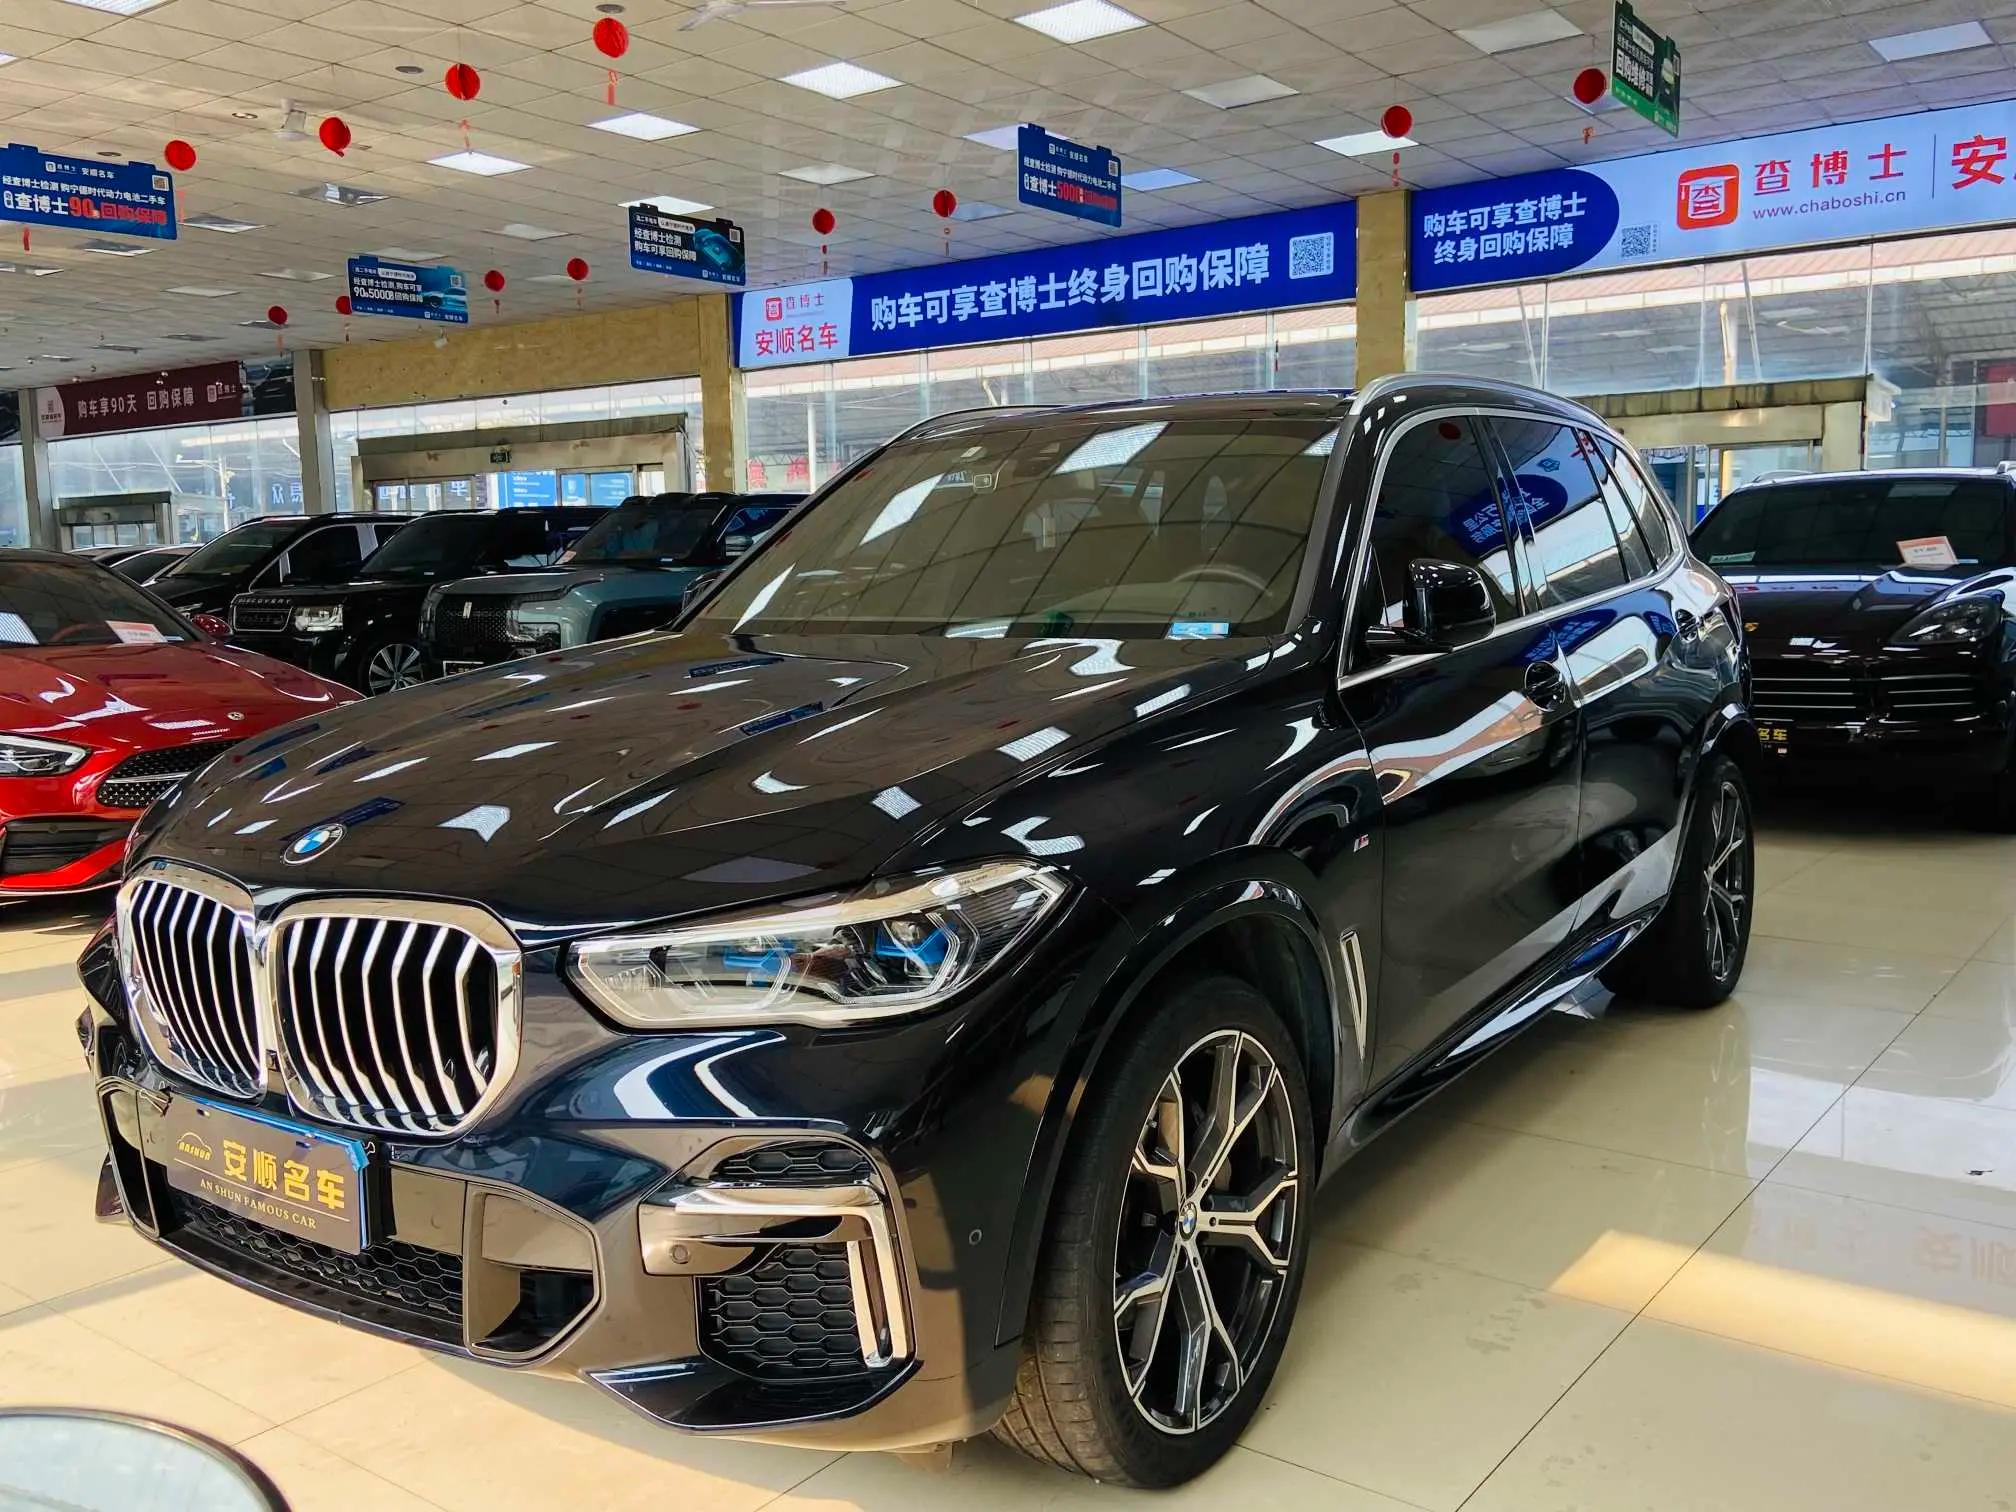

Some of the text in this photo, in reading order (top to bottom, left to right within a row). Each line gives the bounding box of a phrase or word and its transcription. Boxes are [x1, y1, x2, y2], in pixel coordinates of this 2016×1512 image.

[1753, 143, 1908, 196] 查博士
[1951, 134, 2016, 190] 安
[1423, 191, 1588, 239] 购车可享查博士
[1753, 190, 1906, 219] www.chaboshi.cn
[1433, 223, 1575, 265] 终身回购保障
[871, 243, 1270, 332] 购车可享查博士终身回购保障
[755, 322, 838, 357] 安顺名车
[77, 387, 194, 419] 购车享90天 回购保障
[223, 1138, 345, 1210] 安顺名车
[200, 1178, 317, 1230] AN SHUN FAMOUS CAR
